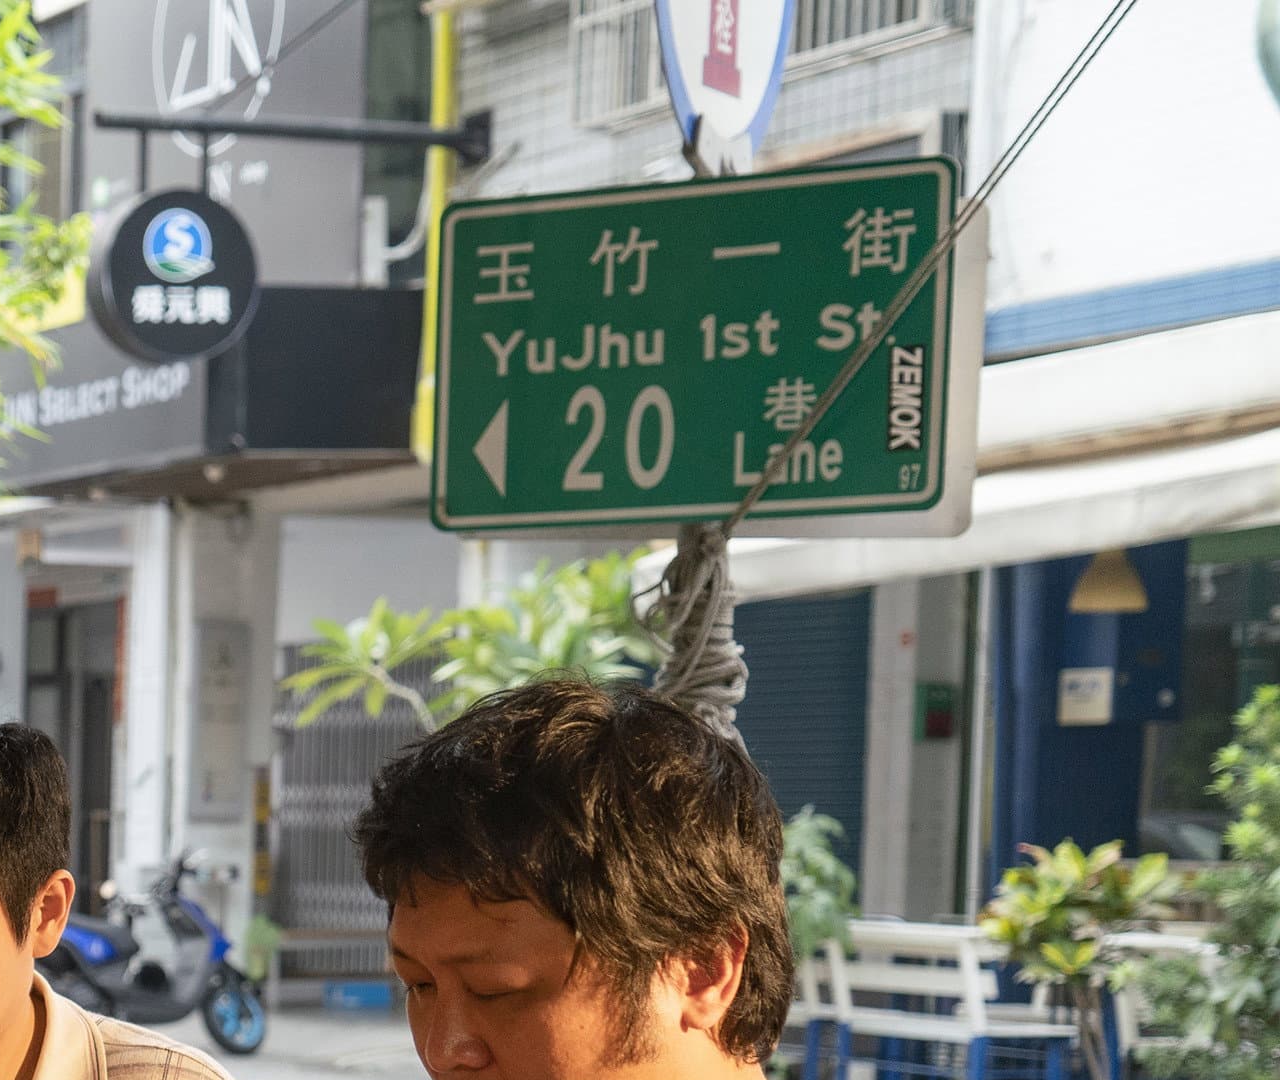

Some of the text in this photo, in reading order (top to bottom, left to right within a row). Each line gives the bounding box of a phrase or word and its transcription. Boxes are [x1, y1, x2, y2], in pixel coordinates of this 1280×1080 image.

[473, 207, 917, 305] 玉竹一街
[482, 325, 665, 377] YuJhu
[700, 311, 780, 361] 1st
[121, 361, 191, 410] SHOP
[763, 376, 818, 432] 巷
[889, 346, 923, 450] ZEMOK
[562, 385, 675, 491] 20
[733, 432, 844, 487] Lane
